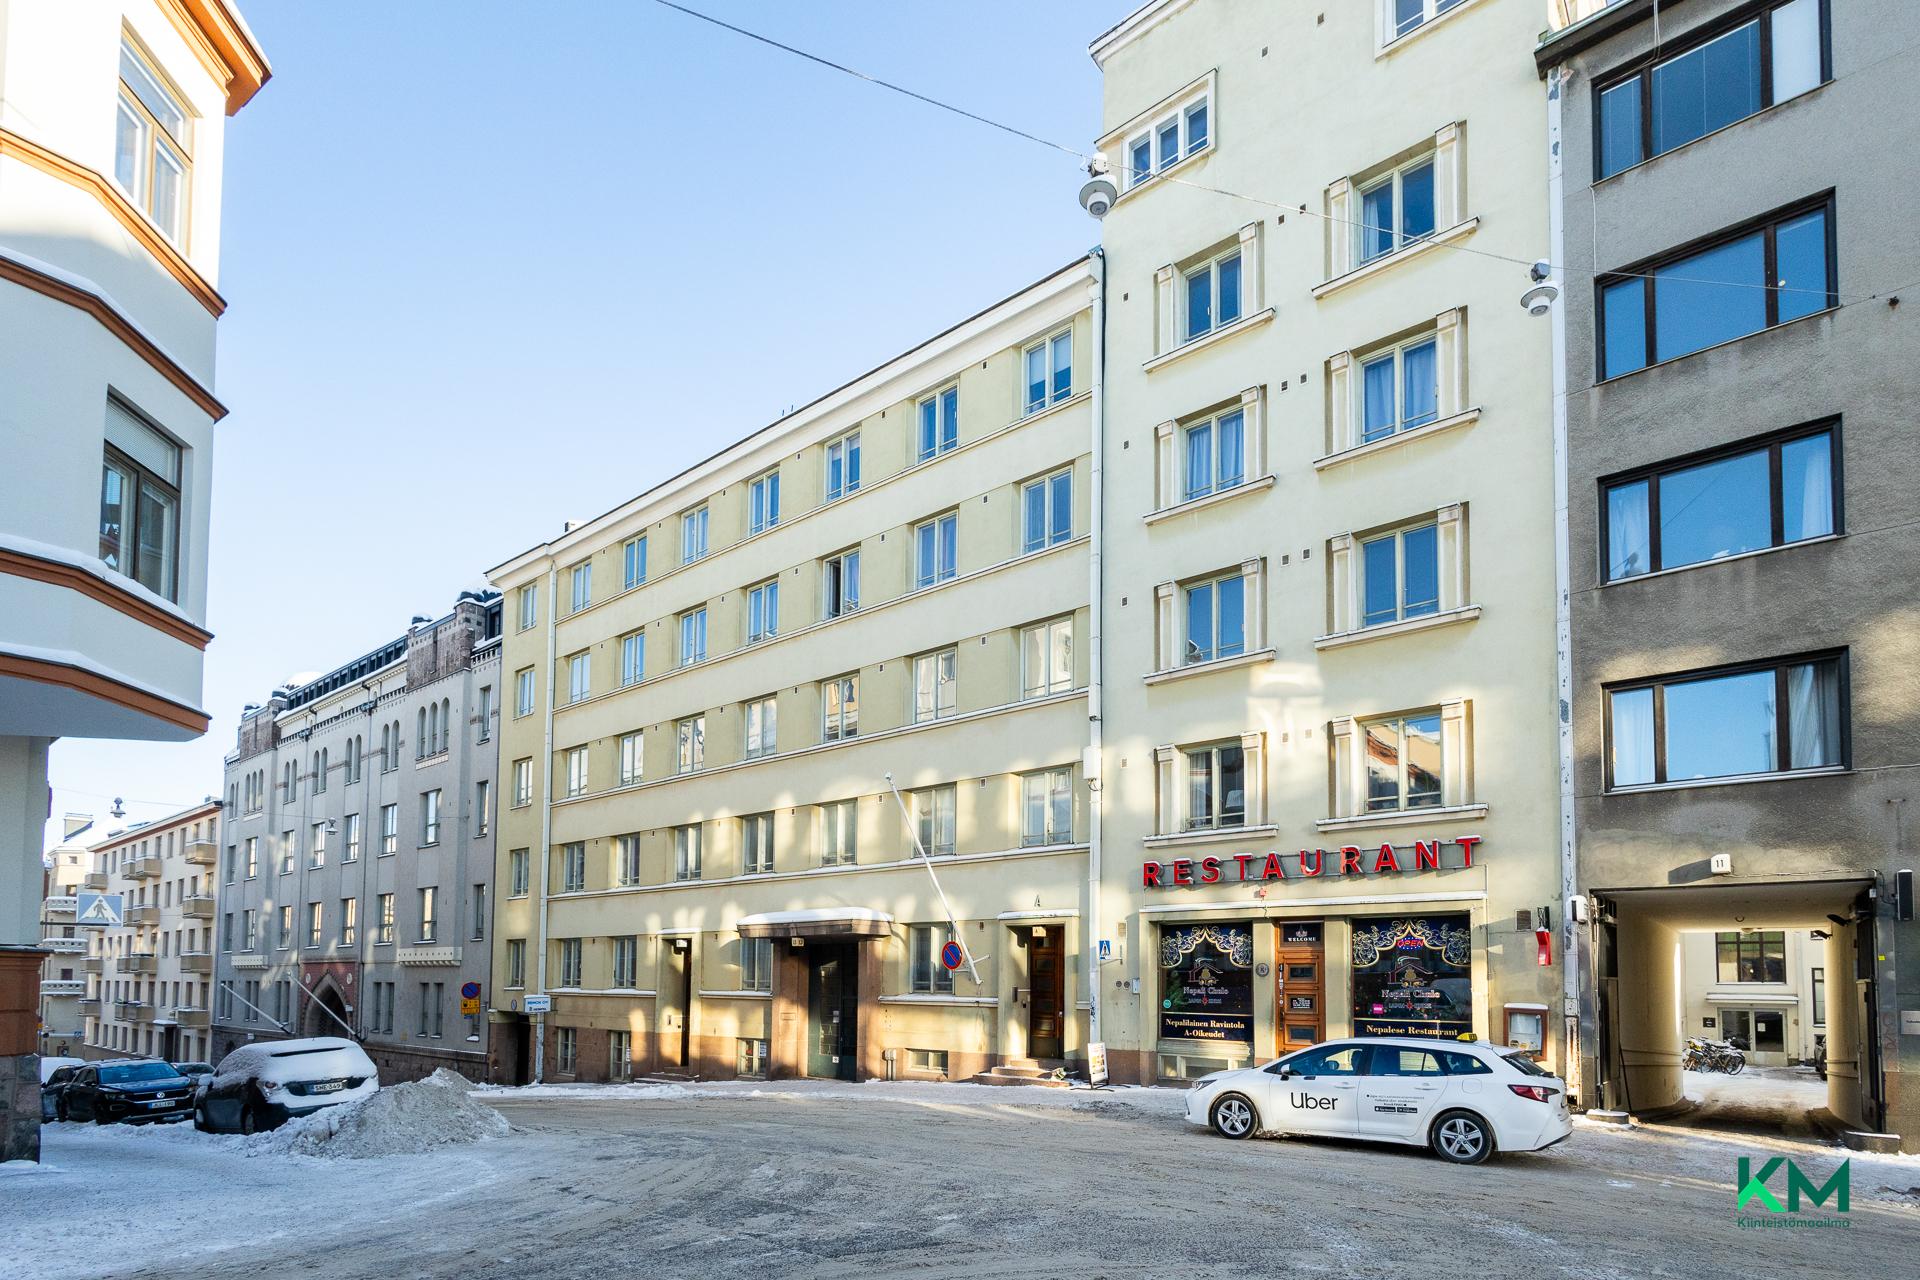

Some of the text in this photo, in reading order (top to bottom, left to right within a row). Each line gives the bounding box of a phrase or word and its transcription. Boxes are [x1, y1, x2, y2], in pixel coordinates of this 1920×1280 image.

[1143, 835, 1482, 887] RESTAURANT
[1716, 859, 1724, 868] 11
[1034, 894, 1041, 907] A
[1397, 939, 1424, 947] OPEN
[1183, 986, 1206, 996] Nepali
[1381, 989, 1441, 1000] Nepali Chulo
[1165, 1018, 1245, 1029] Nepalilainen Ravintola
[1184, 1029, 1225, 1038] A-Oikeudet
[1366, 1024, 1458, 1036] Nepalese Restaurant
[1290, 1091, 1339, 1111] Uber
